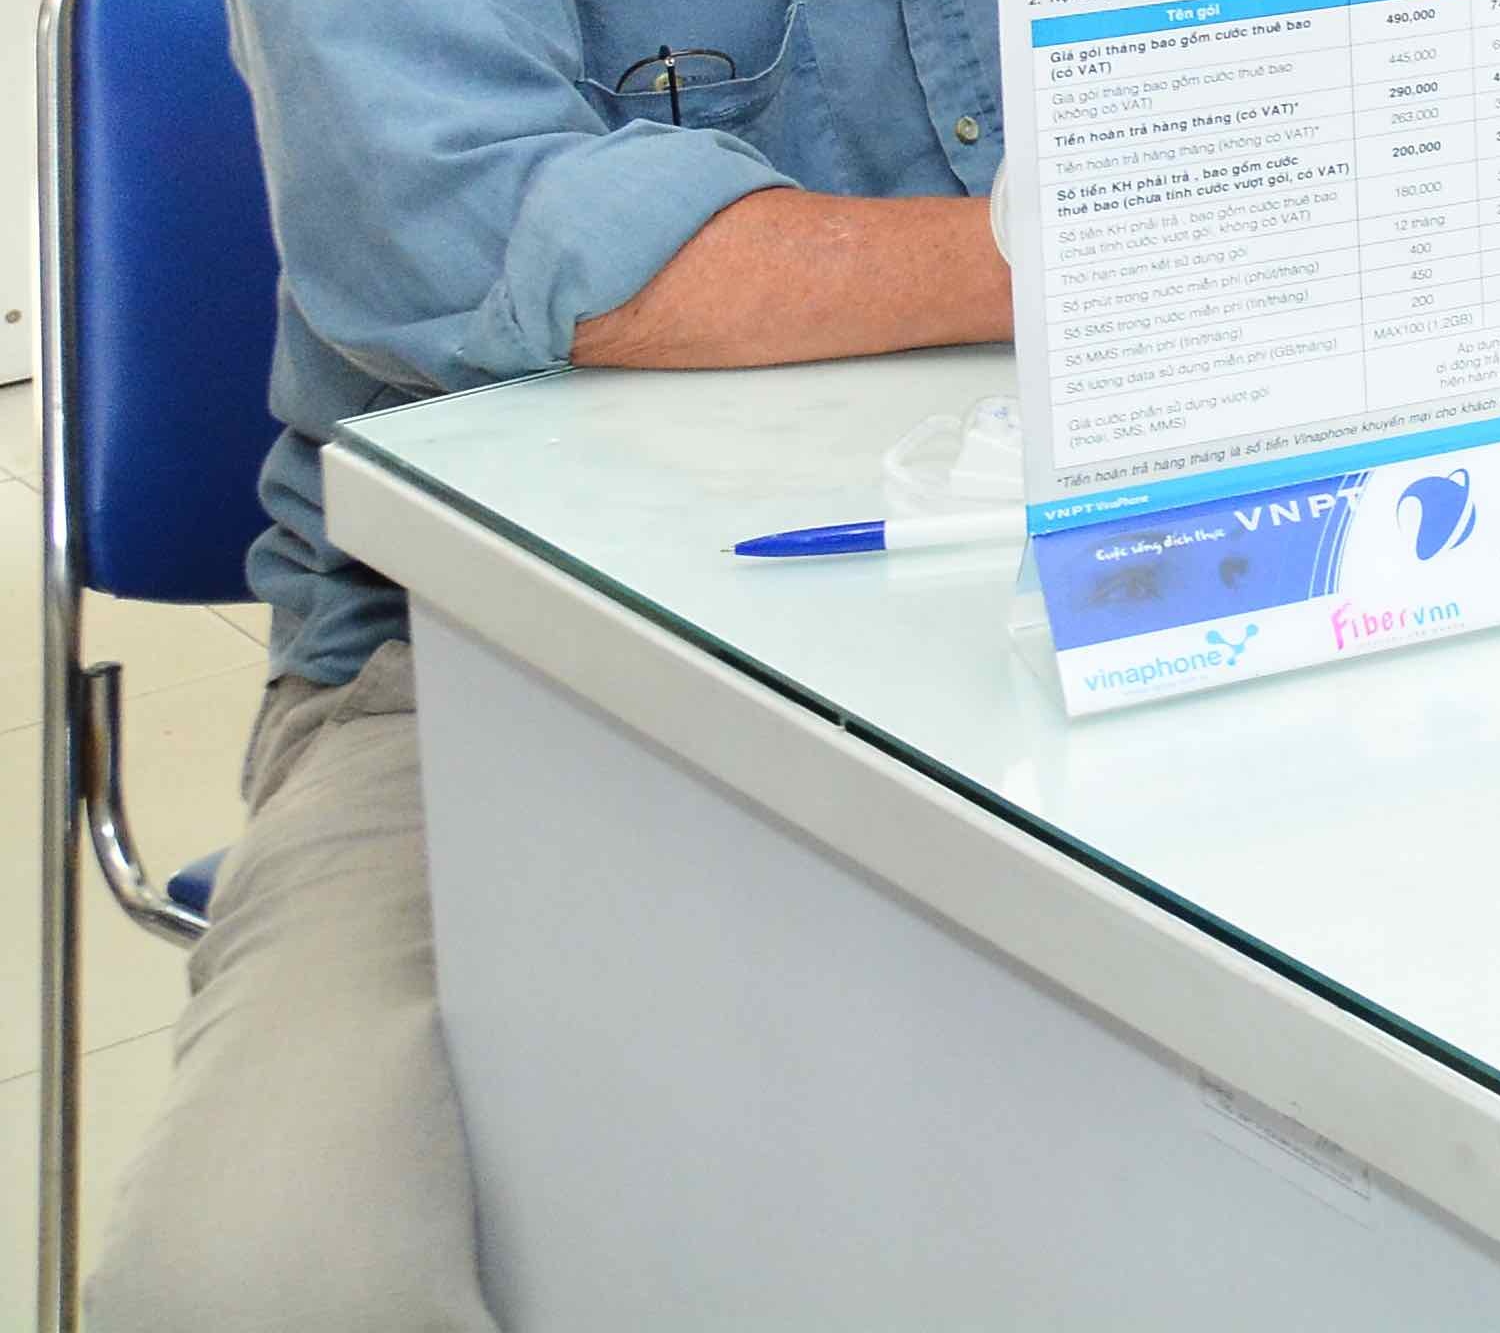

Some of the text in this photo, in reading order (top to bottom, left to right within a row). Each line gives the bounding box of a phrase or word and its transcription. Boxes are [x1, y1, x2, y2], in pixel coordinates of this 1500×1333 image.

[1234, 485, 1366, 532] VNPT
[1330, 600, 1461, 651] Fibervnn
[1083, 648, 1224, 692] vinaphone
